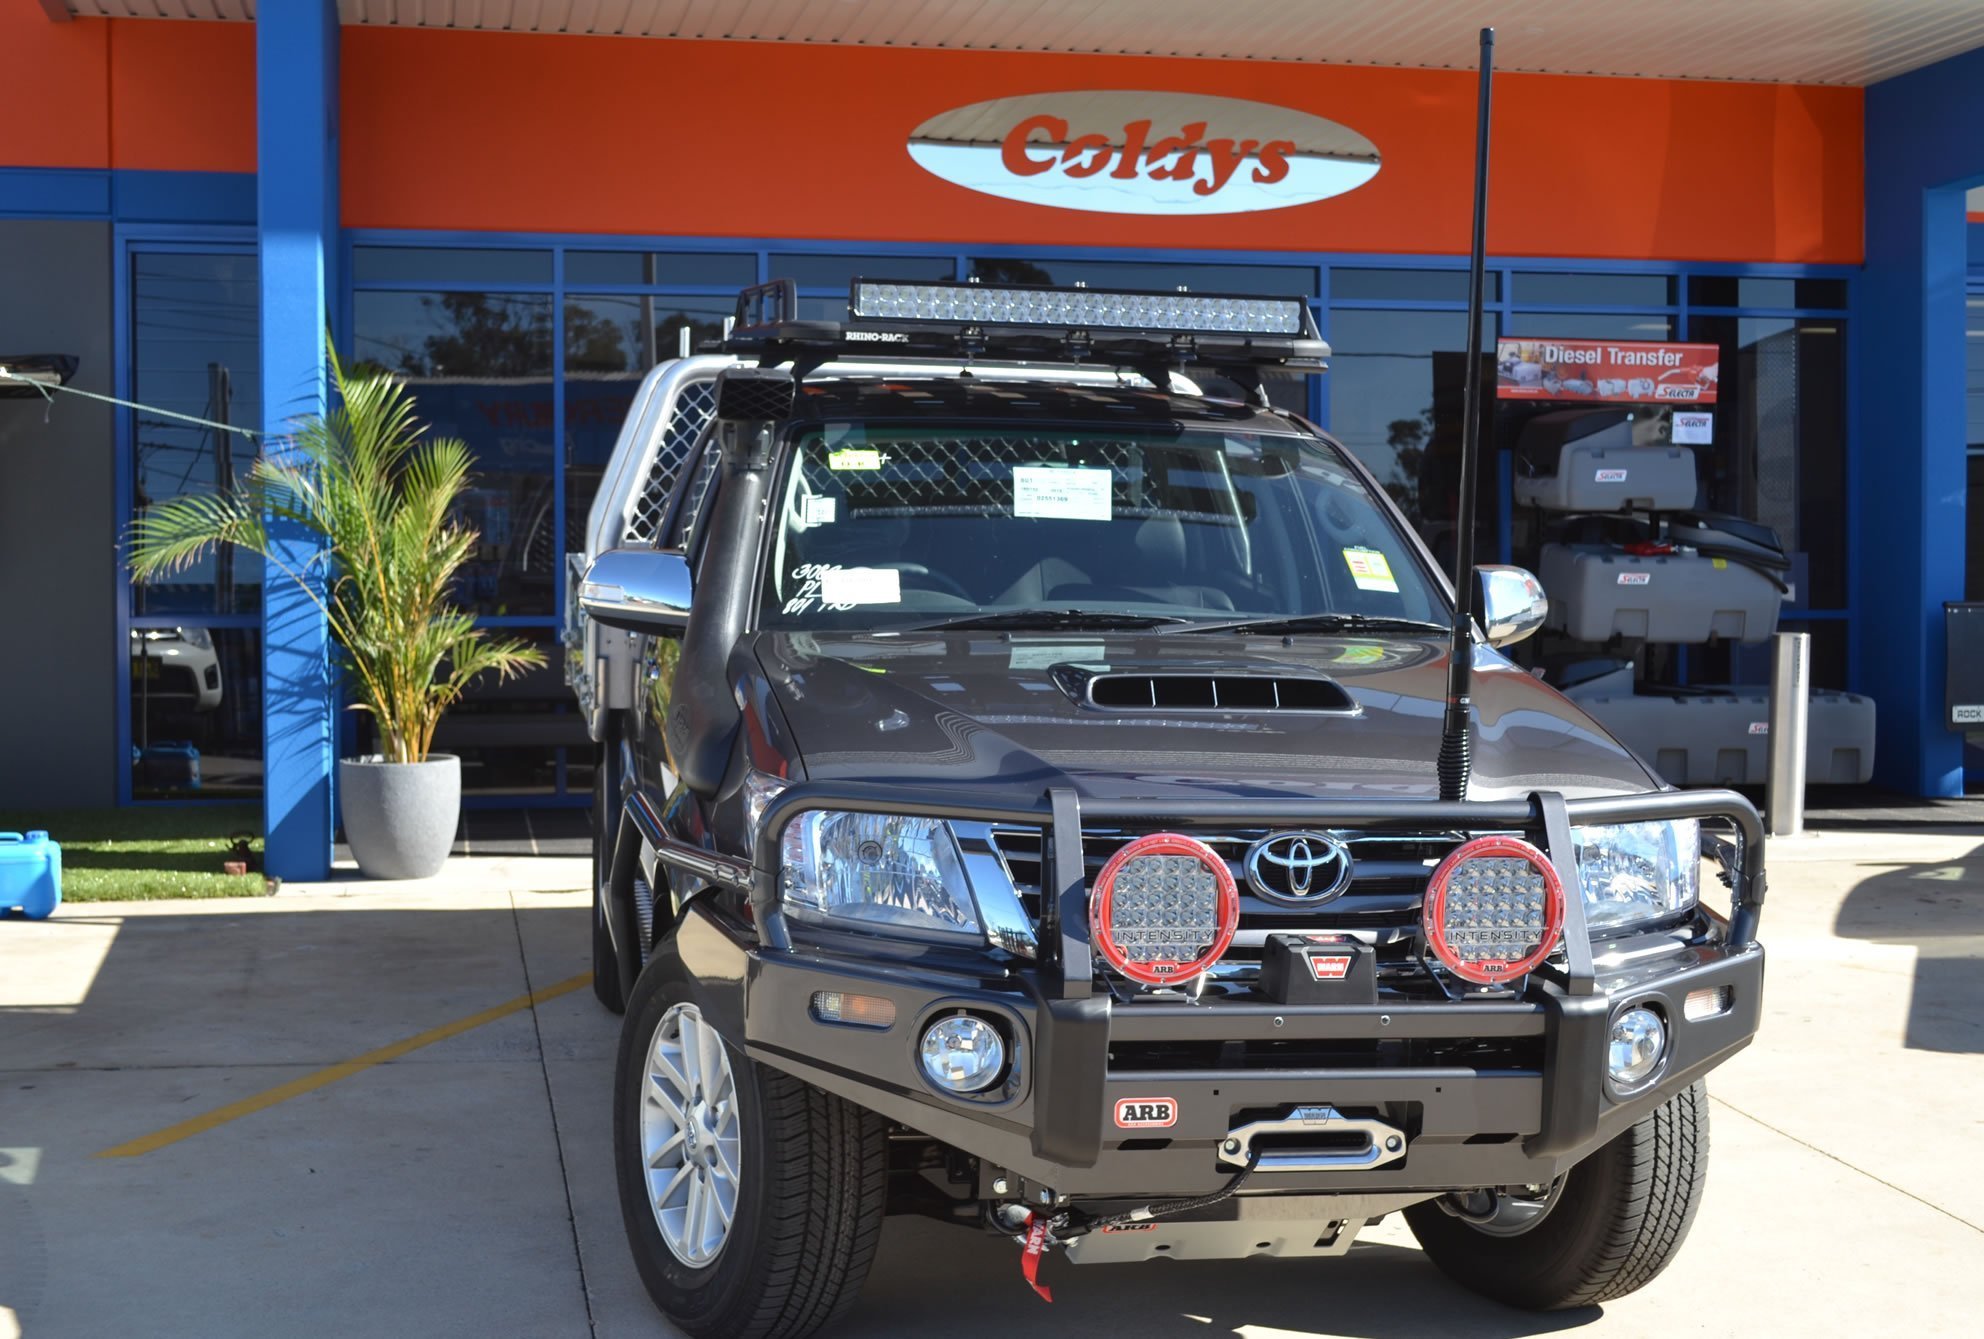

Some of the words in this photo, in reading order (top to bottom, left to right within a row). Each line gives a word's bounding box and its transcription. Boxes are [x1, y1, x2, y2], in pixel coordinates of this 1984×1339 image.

[1001, 114, 1296, 196] Coldys
[845, 331, 909, 343] RHINO-RACK
[1544, 346, 1602, 364] Diesel
[1607, 347, 1683, 366] Transfer
[1117, 930, 1214, 941] INTENSITY
[1450, 930, 1542, 941] INTENSITY
[1153, 966, 1175, 974] ARB
[1483, 965, 1504, 973] ARB
[1123, 1105, 1170, 1121] ARB
[1027, 1219, 1046, 1255] WARN
